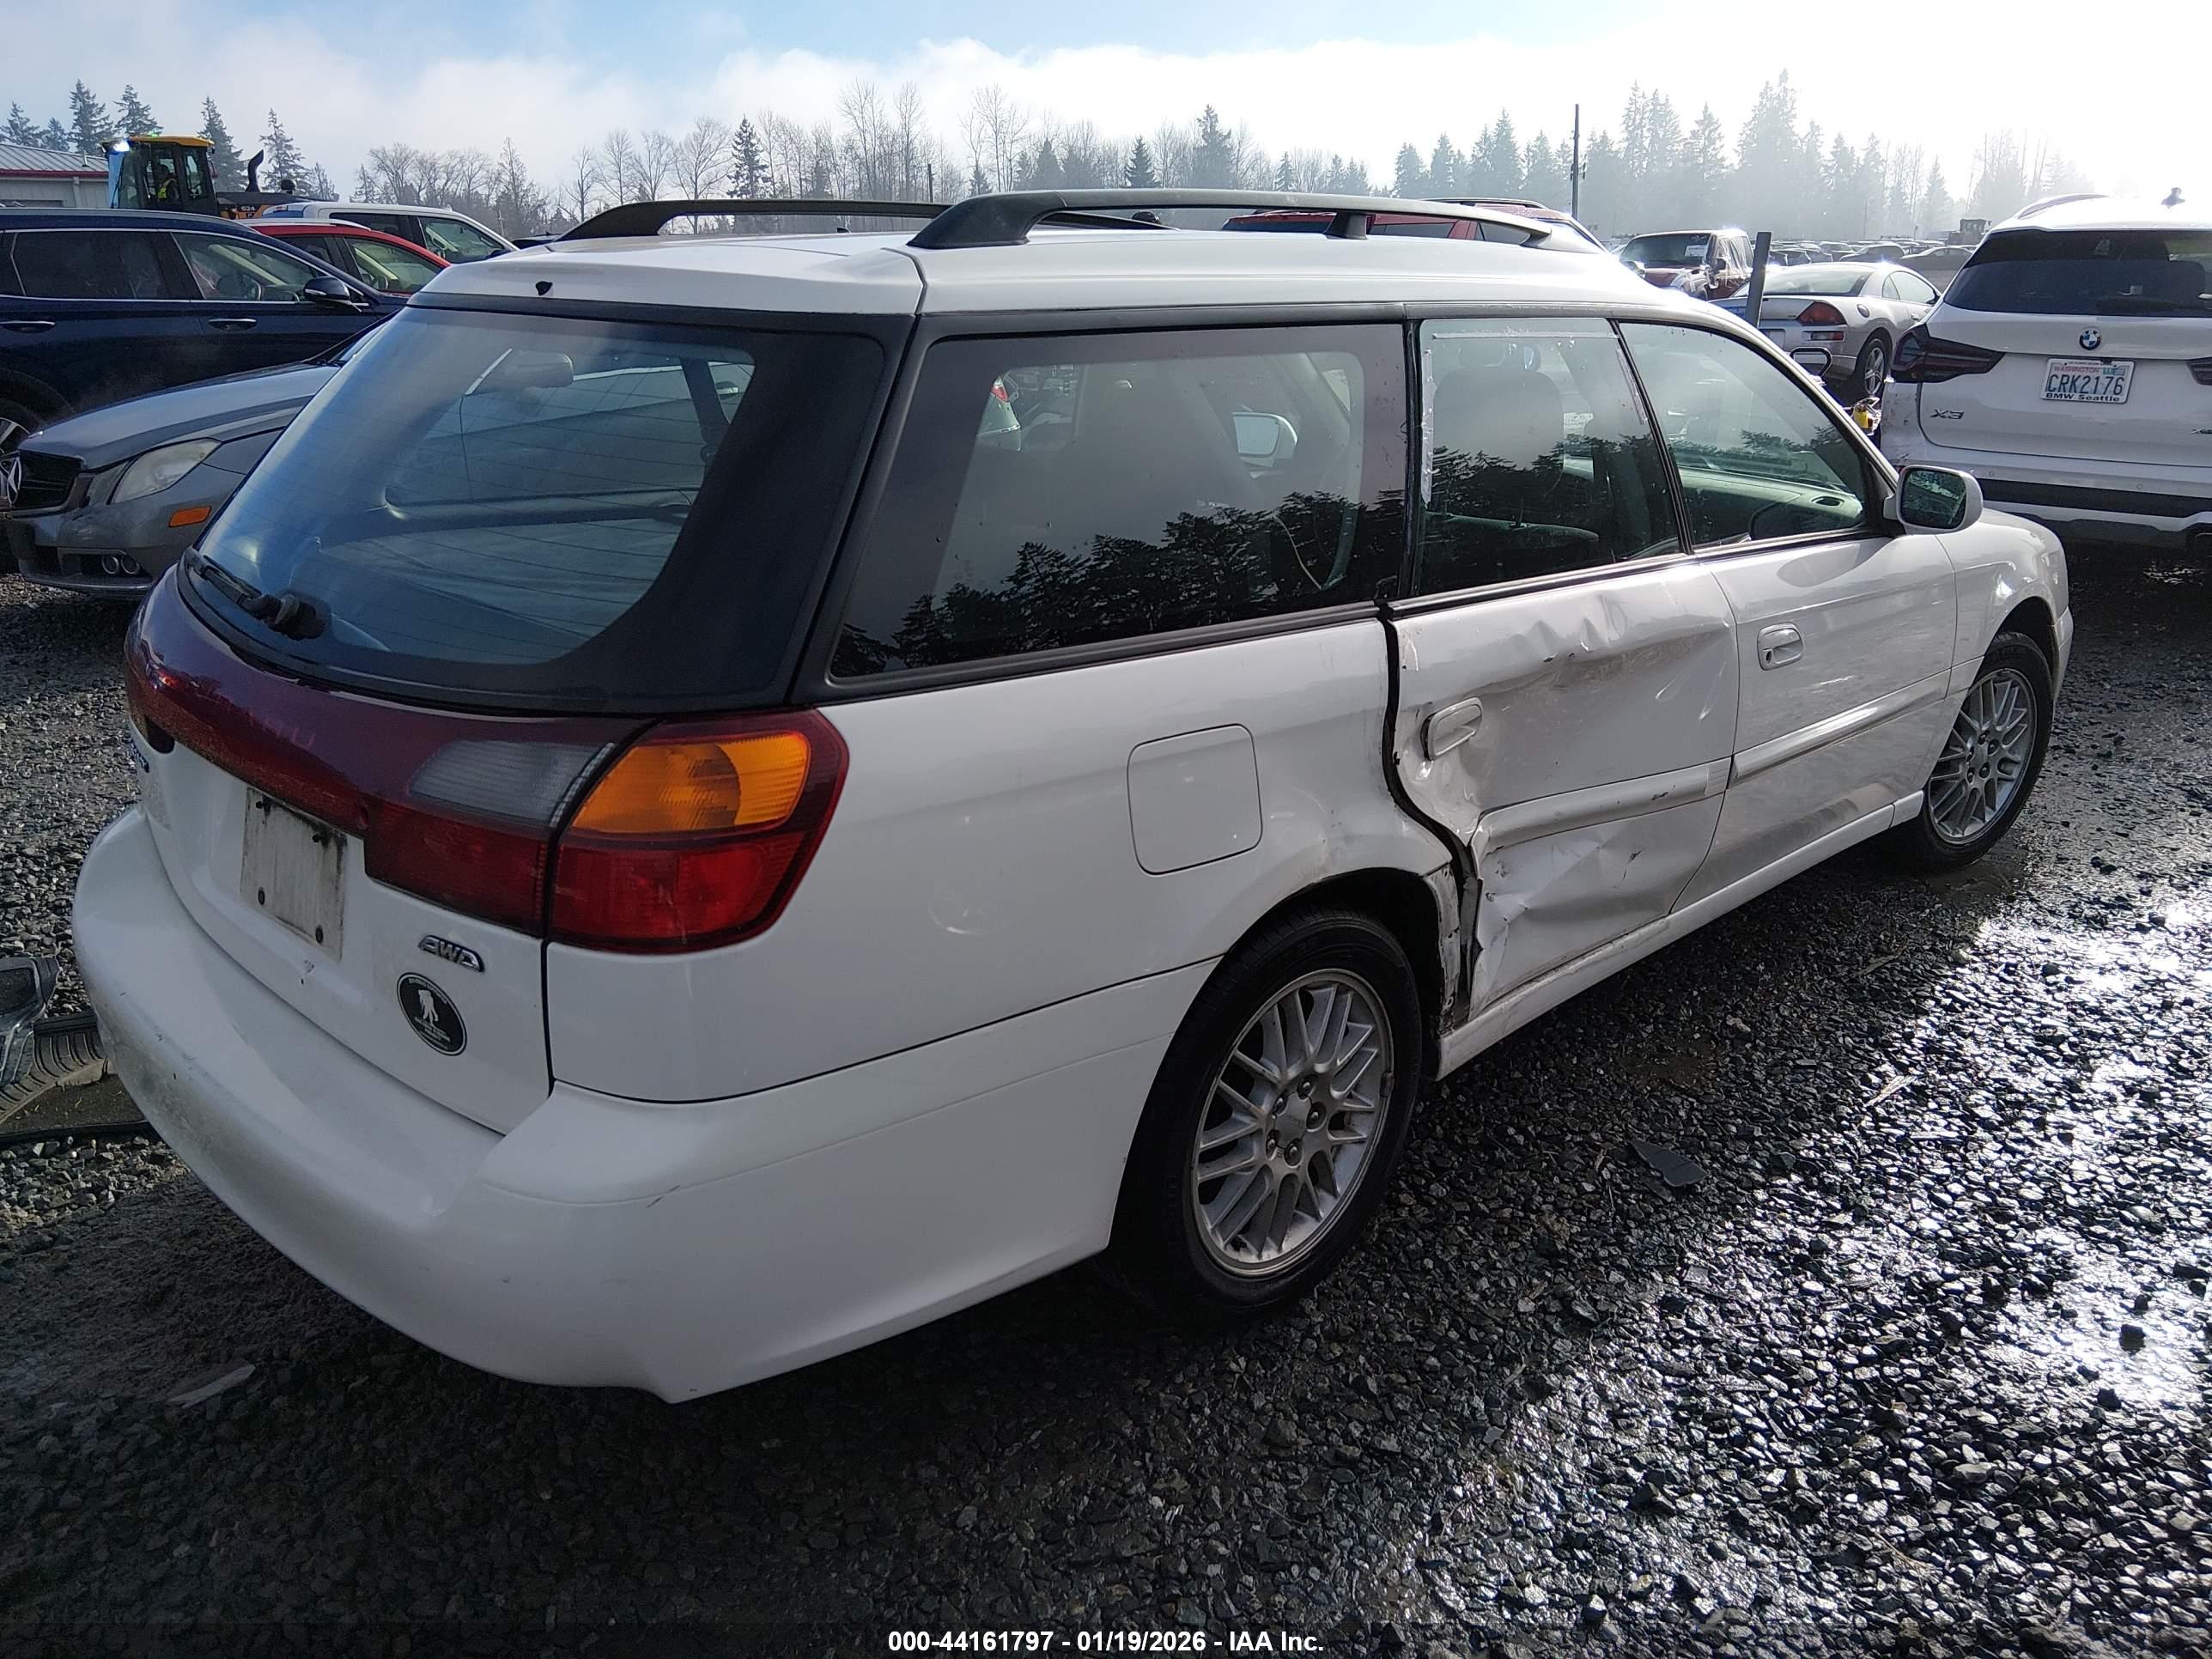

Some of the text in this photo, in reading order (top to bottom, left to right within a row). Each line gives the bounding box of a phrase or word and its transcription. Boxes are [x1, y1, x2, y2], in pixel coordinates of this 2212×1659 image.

[2047, 374, 2125, 396] CRK2176
[1929, 409, 1965, 419] X3
[417, 934, 485, 973] AWD
